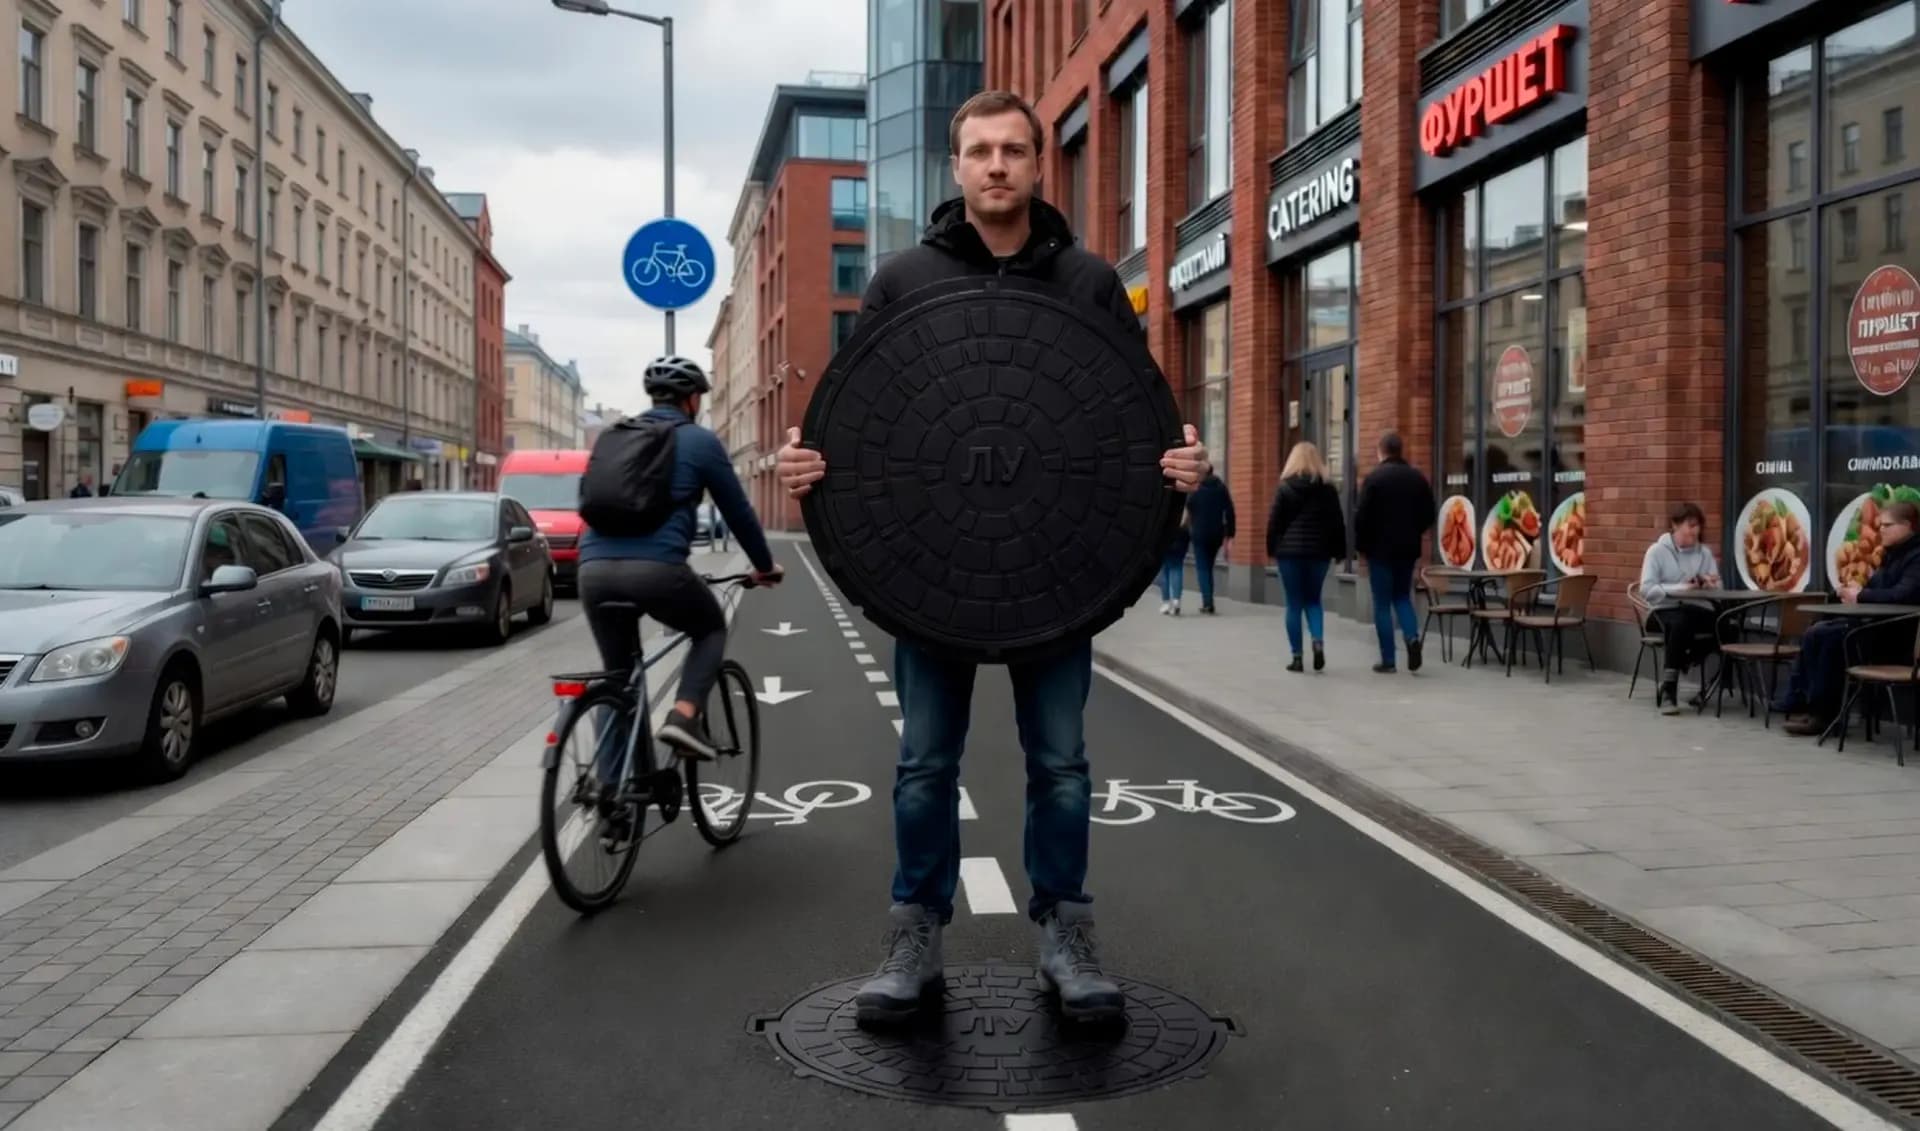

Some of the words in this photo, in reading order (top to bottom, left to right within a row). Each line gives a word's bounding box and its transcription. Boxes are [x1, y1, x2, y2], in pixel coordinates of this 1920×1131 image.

[1420, 25, 1570, 156] ФУРШЕТ
[1268, 158, 1354, 241] CATERING
[960, 445, 1025, 486] ЛУ
